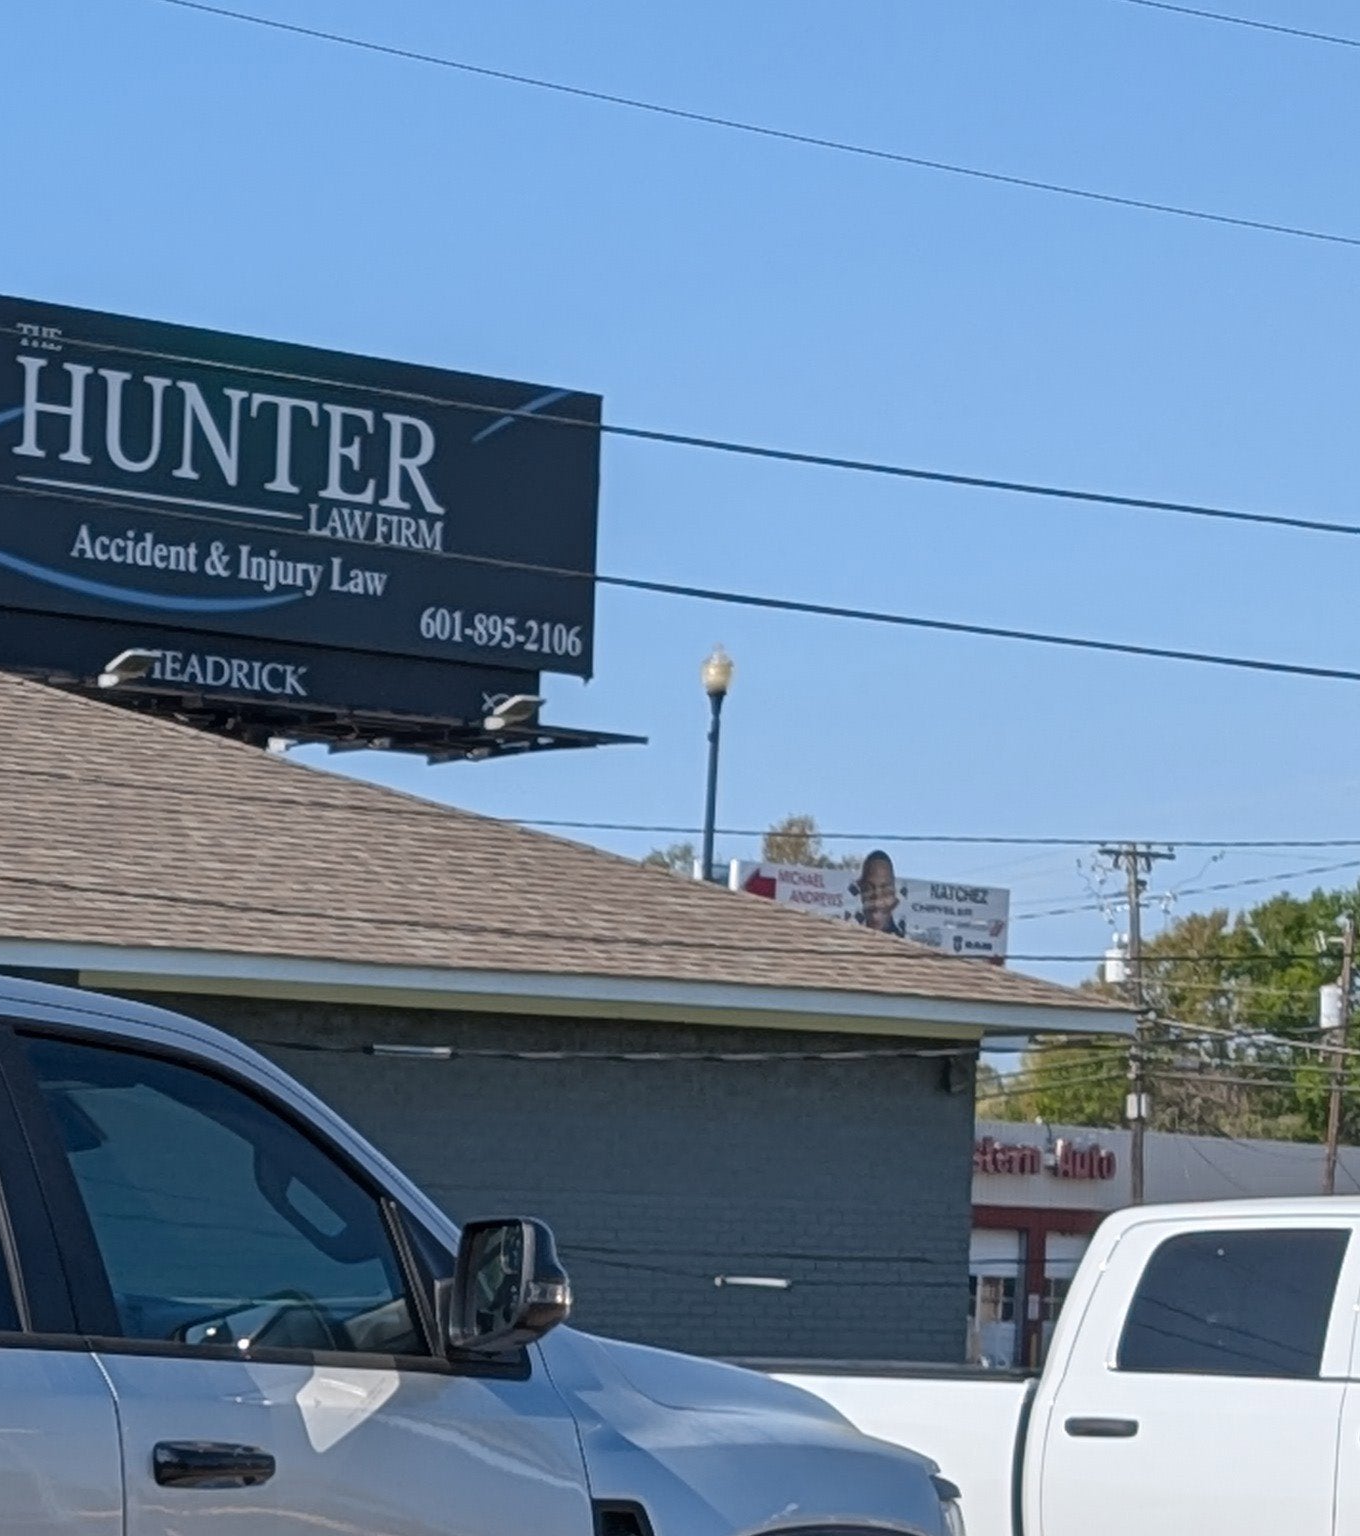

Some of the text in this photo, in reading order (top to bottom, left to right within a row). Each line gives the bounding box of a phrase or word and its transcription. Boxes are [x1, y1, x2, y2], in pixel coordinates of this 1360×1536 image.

[12, 355, 446, 514] HUNTER
[307, 503, 444, 551] LAW FIRM
[70, 524, 388, 597] Accident & Injury Law
[420, 606, 583, 657] 601-895-2106
